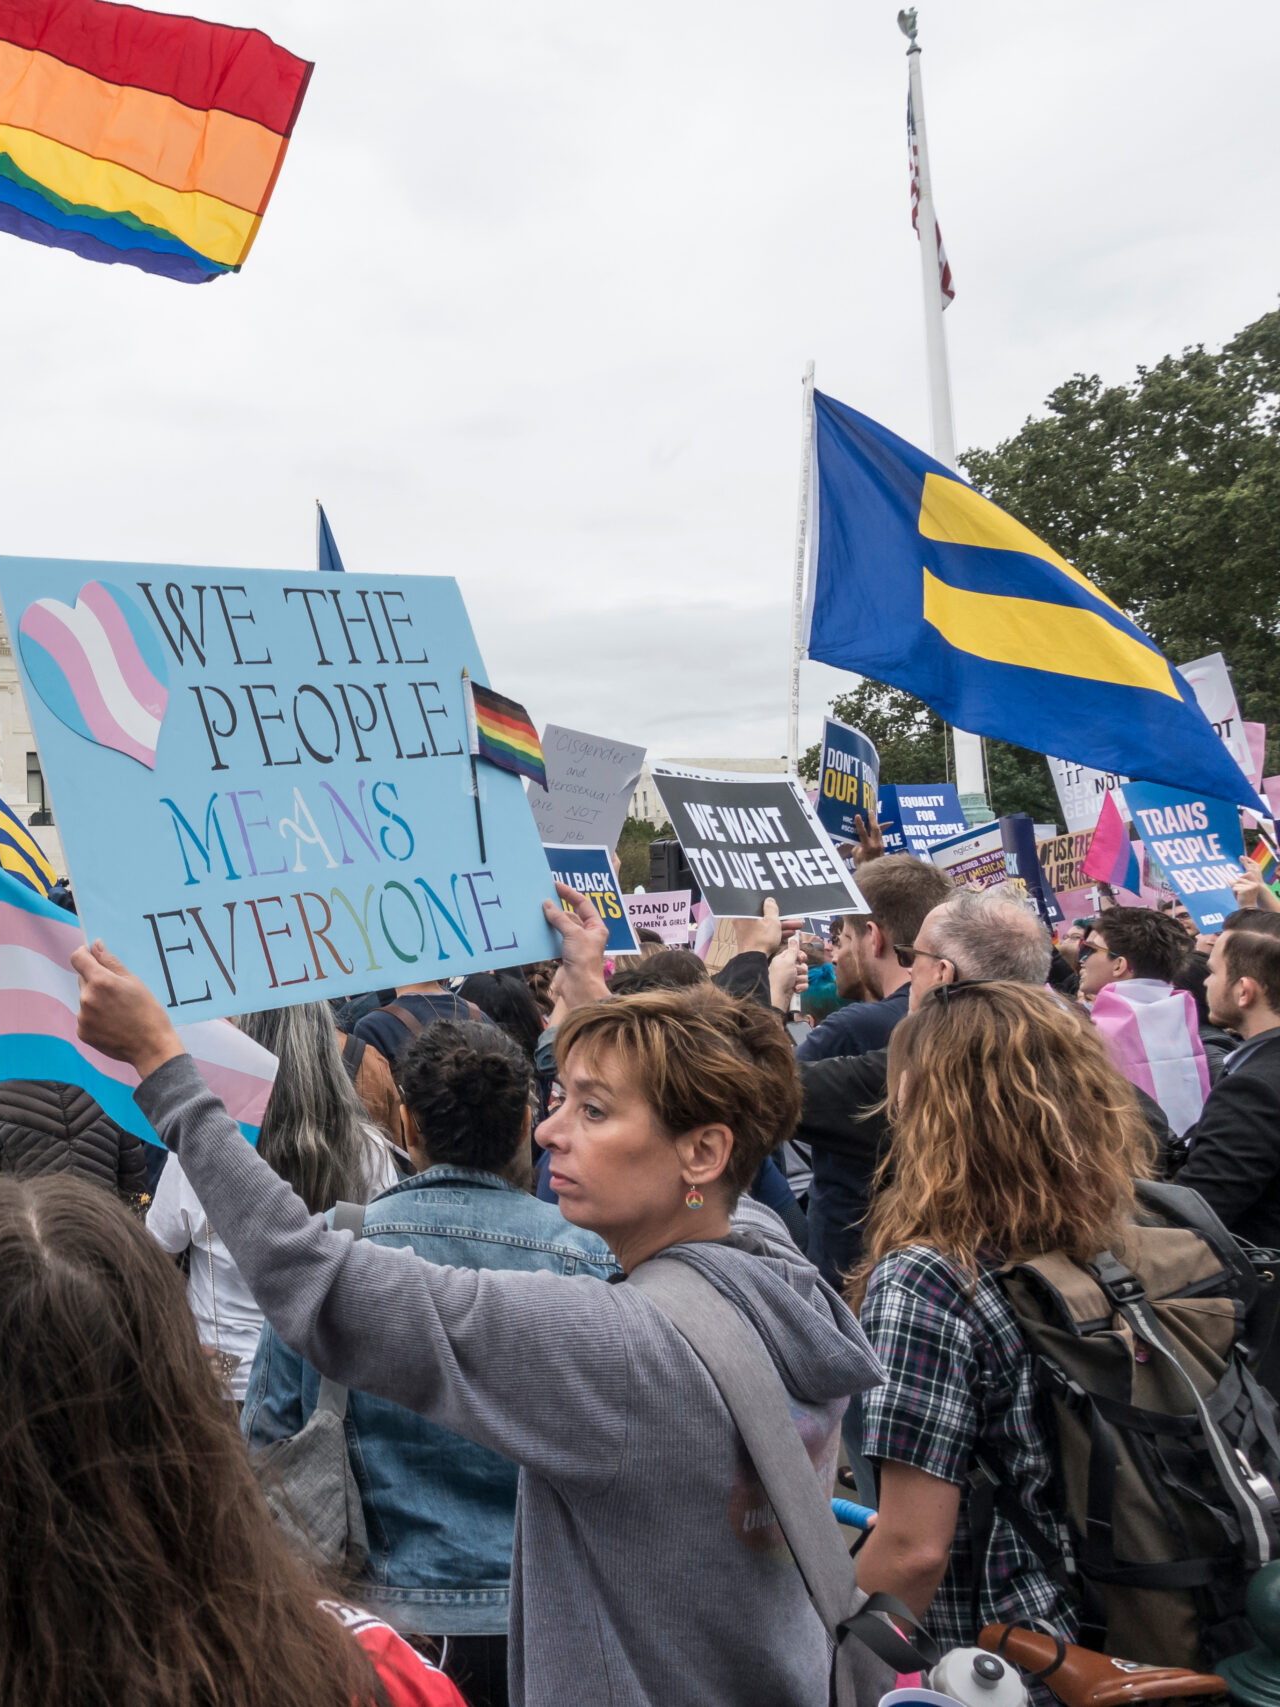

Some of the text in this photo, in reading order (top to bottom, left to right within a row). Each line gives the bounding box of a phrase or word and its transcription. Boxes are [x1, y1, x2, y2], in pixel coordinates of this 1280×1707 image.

[137, 582, 428, 667] WE THE
[189, 682, 463, 771] PEOPLE
[826, 747, 860, 778] DON'T
[823, 768, 858, 806] OUR
[1094, 774, 1122, 794] NOT
[566, 805, 602, 821] NOT
[898, 795, 945, 808] EQUALITY
[915, 810, 937, 822] FOR
[160, 780, 414, 885] MEANS
[682, 801, 791, 845] WE WANT
[928, 823, 965, 836] PEOPLE
[1136, 801, 1209, 836] TRANS
[1150, 833, 1227, 866] PEOPLE
[684, 847, 726, 888] TO
[718, 850, 775, 891] LIVE
[765, 848, 842, 889] FREE
[1170, 863, 1245, 895] BELONG
[628, 902, 670, 915] STAND
[672, 901, 687, 912] UP
[668, 918, 687, 927] GIRLS
[1200, 912, 1225, 926] ACLU
[143, 871, 518, 1007] EVERYONE
